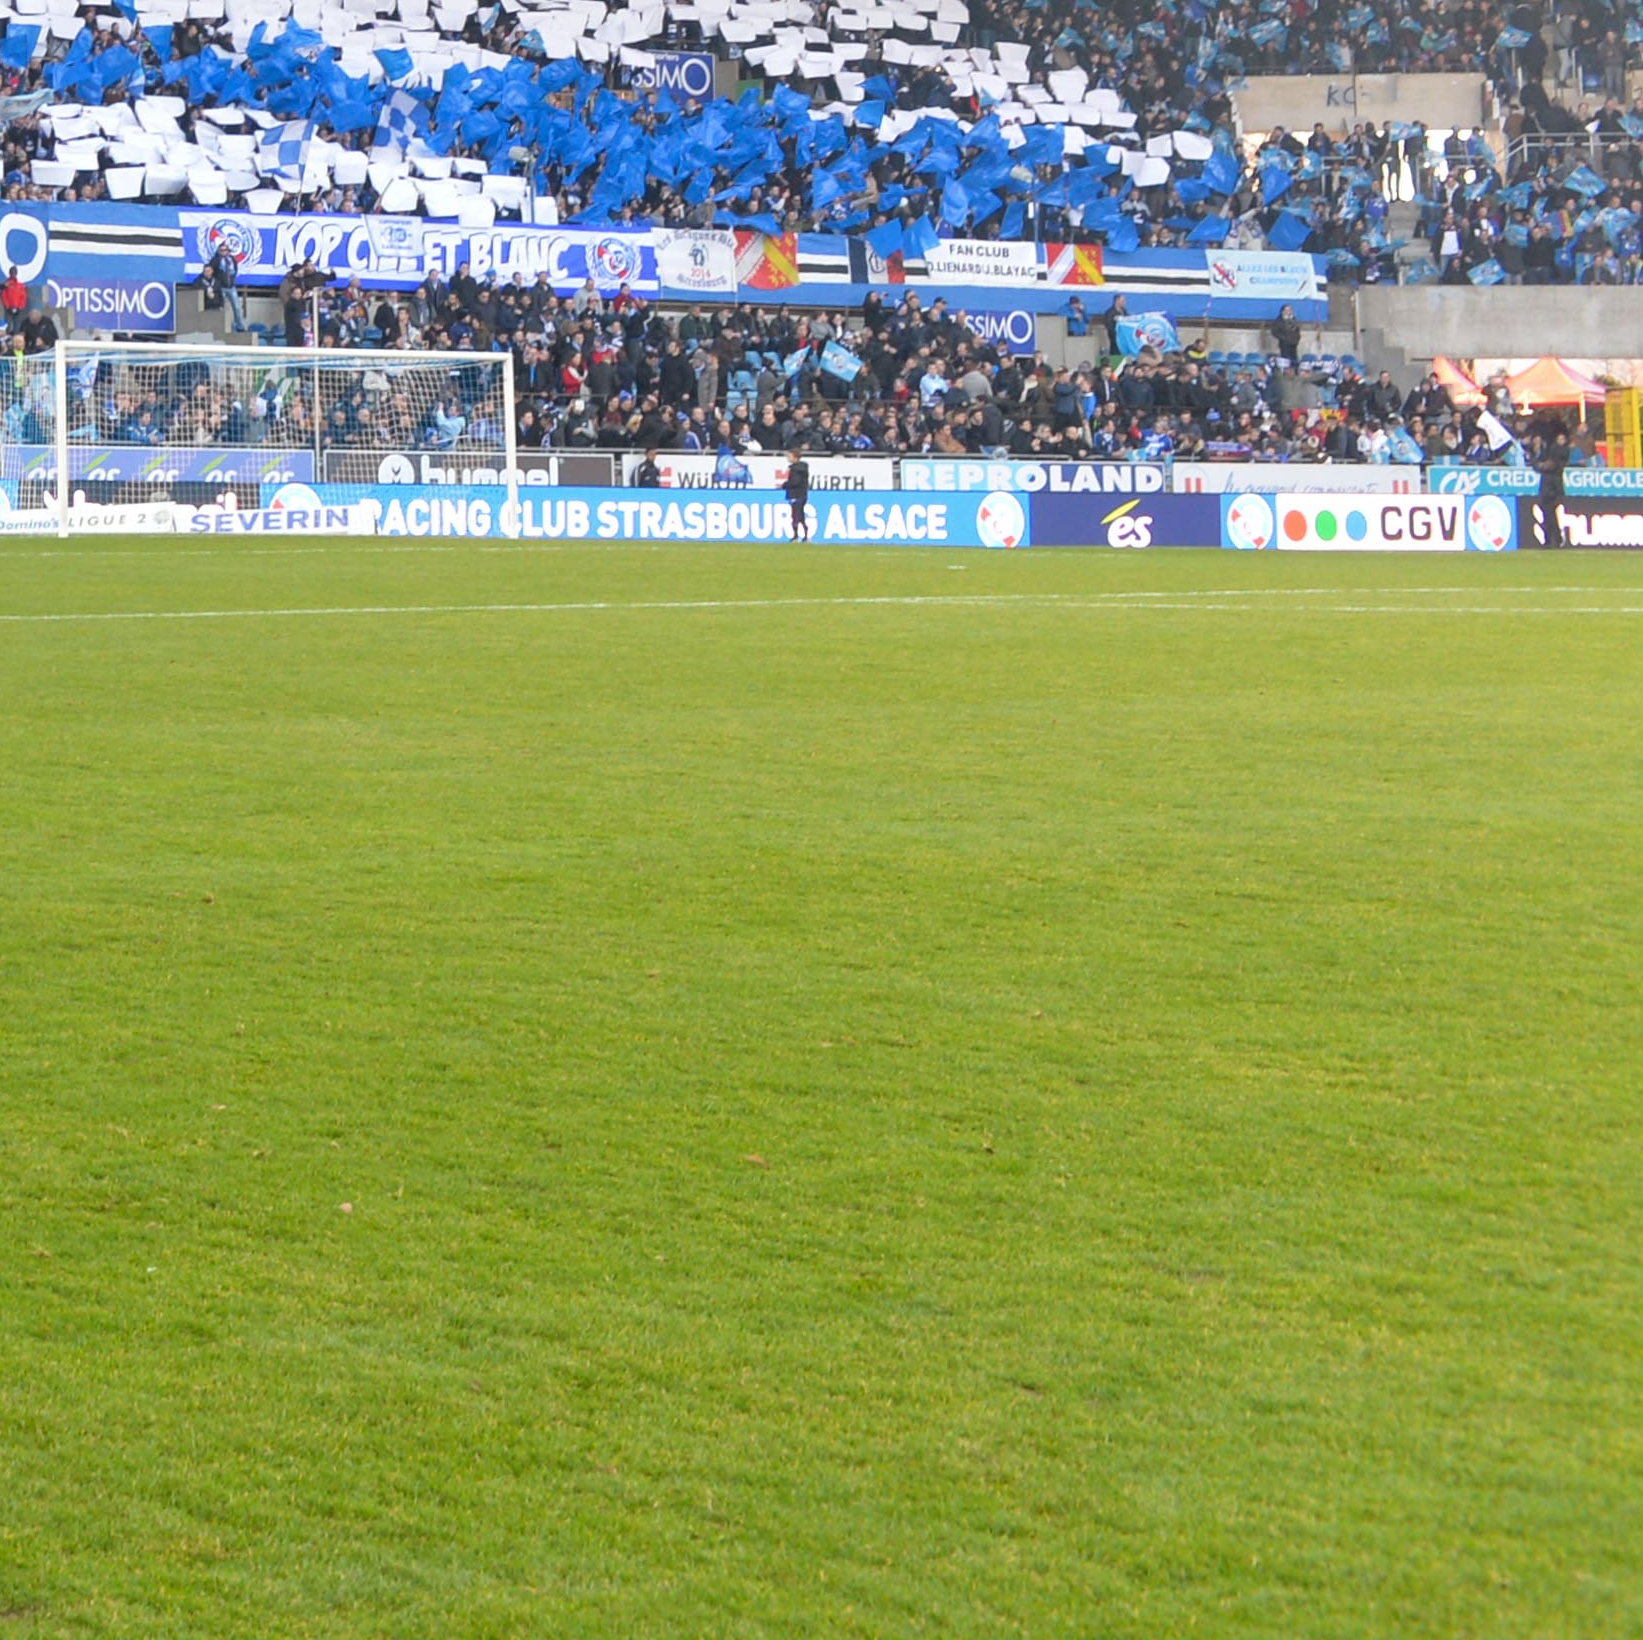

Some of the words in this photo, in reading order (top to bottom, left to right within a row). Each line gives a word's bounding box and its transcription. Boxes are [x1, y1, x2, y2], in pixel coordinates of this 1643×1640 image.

[275, 220, 346, 271] KOP
[423, 232, 463, 271] ET
[469, 234, 571, 281] BLANC
[949, 244, 973, 256] FAN
[976, 246, 1010, 258] CLUB
[906, 464, 1164, 493] REPROLAND
[1487, 470, 1538, 487] CRED
[68, 515, 125, 528] LIGUE
[136, 513, 146, 524] 2
[191, 508, 350, 533] SEVERIN
[500, 499, 588, 538] CLUB
[597, 501, 816, 541] STRASBOURG
[819, 504, 947, 540] ALSACE
[1380, 506, 1457, 542] CGV
